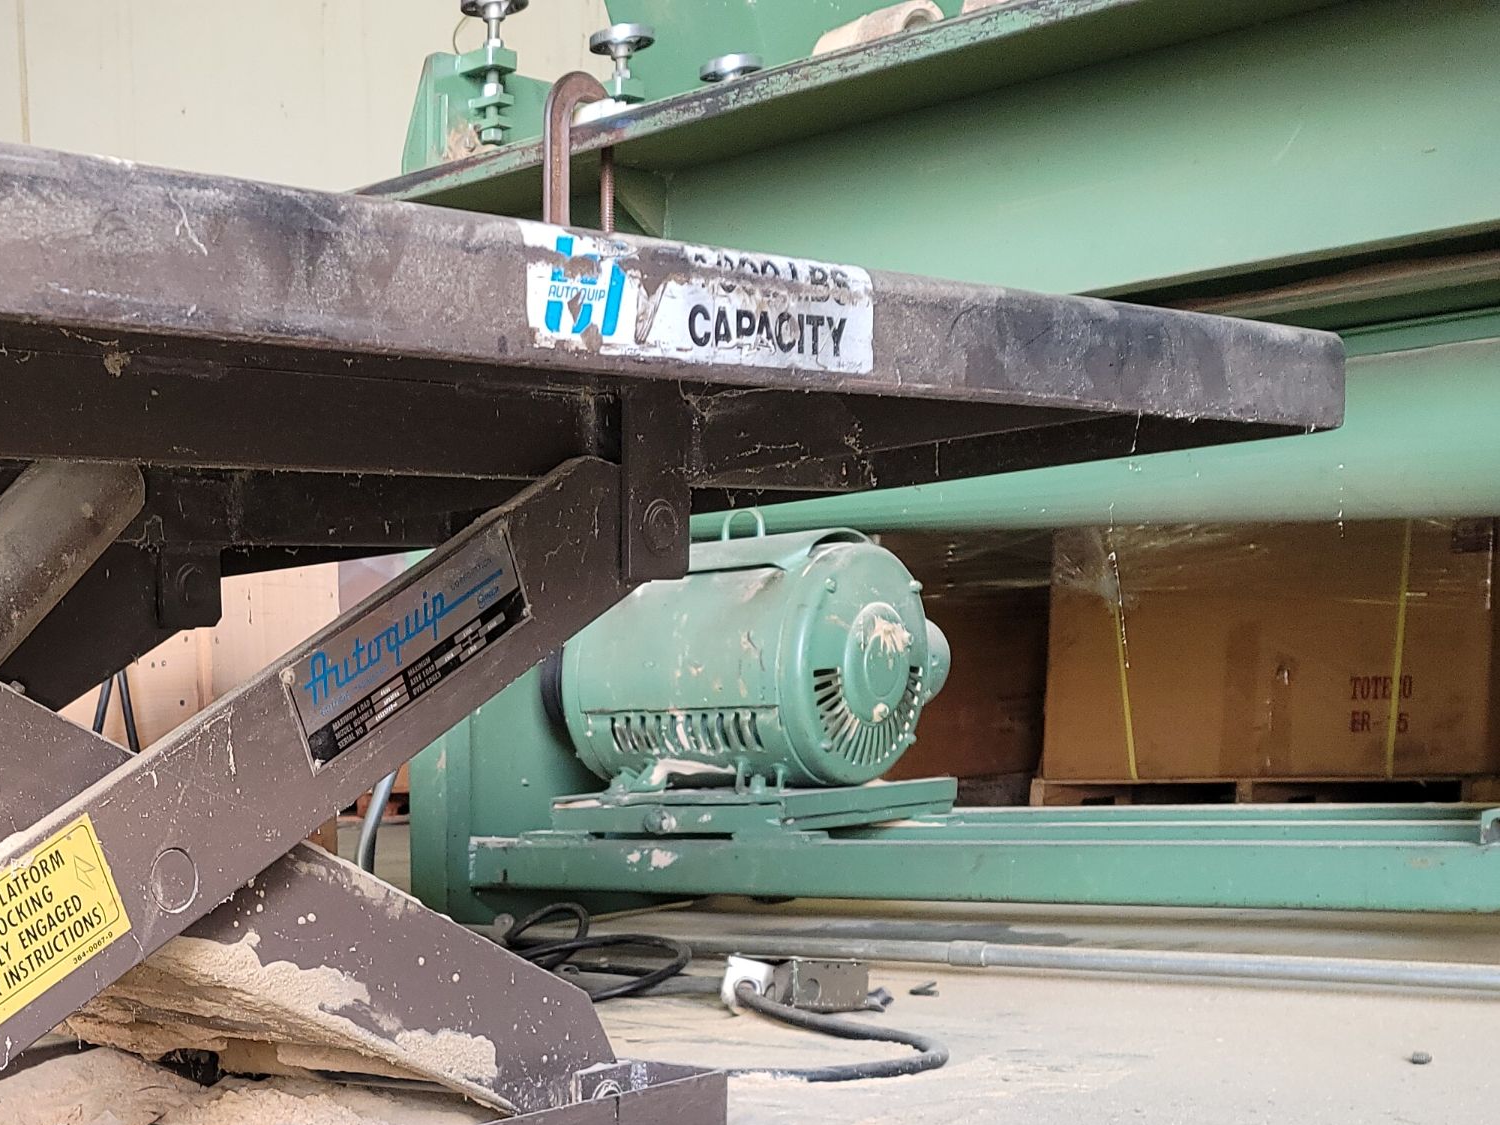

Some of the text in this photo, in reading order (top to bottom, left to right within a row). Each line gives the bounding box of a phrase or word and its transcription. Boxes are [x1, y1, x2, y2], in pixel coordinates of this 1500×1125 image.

[688, 304, 847, 356] CAPACITY
[304, 591, 446, 706] Autoquip
[3, 903, 108, 990] INSTRUCTIONS)
[18, 895, 82, 950] ENGAGED
